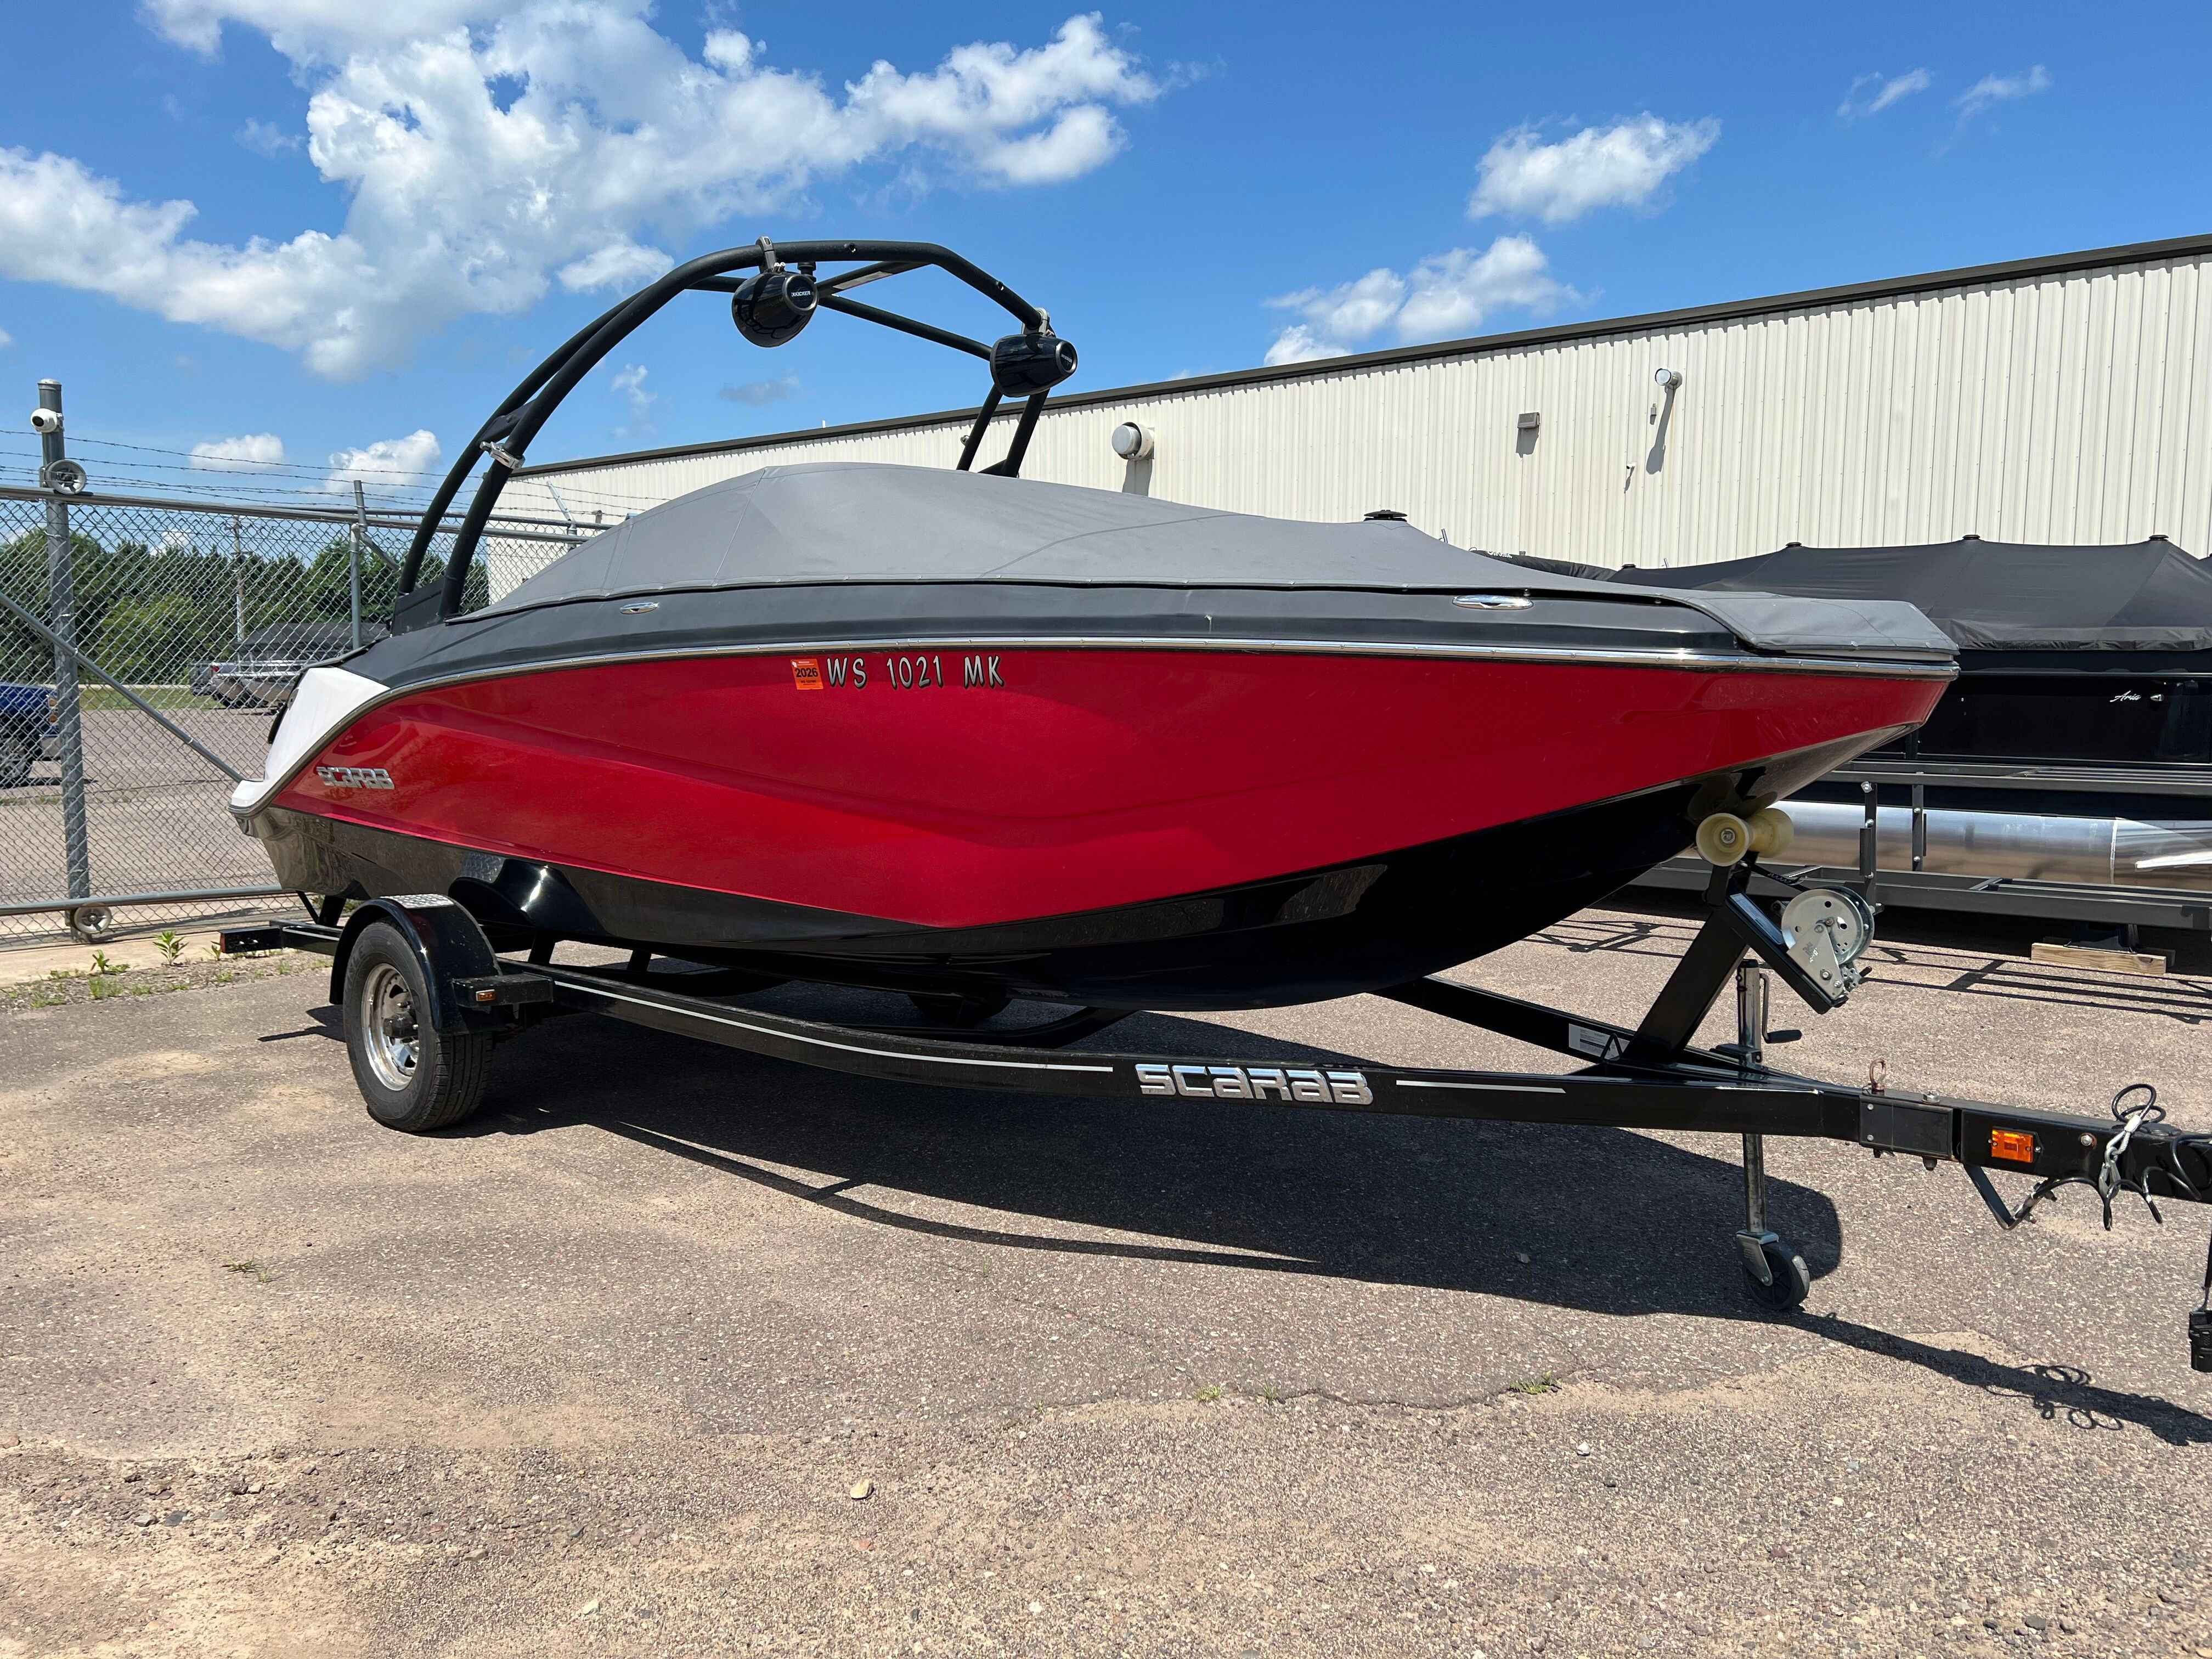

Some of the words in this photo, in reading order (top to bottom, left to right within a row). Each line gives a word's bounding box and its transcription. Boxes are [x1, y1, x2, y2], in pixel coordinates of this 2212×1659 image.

[794, 667, 819, 678] 2026
[827, 656, 867, 689] WS
[887, 656, 944, 689] 1021
[964, 655, 1004, 689] MK
